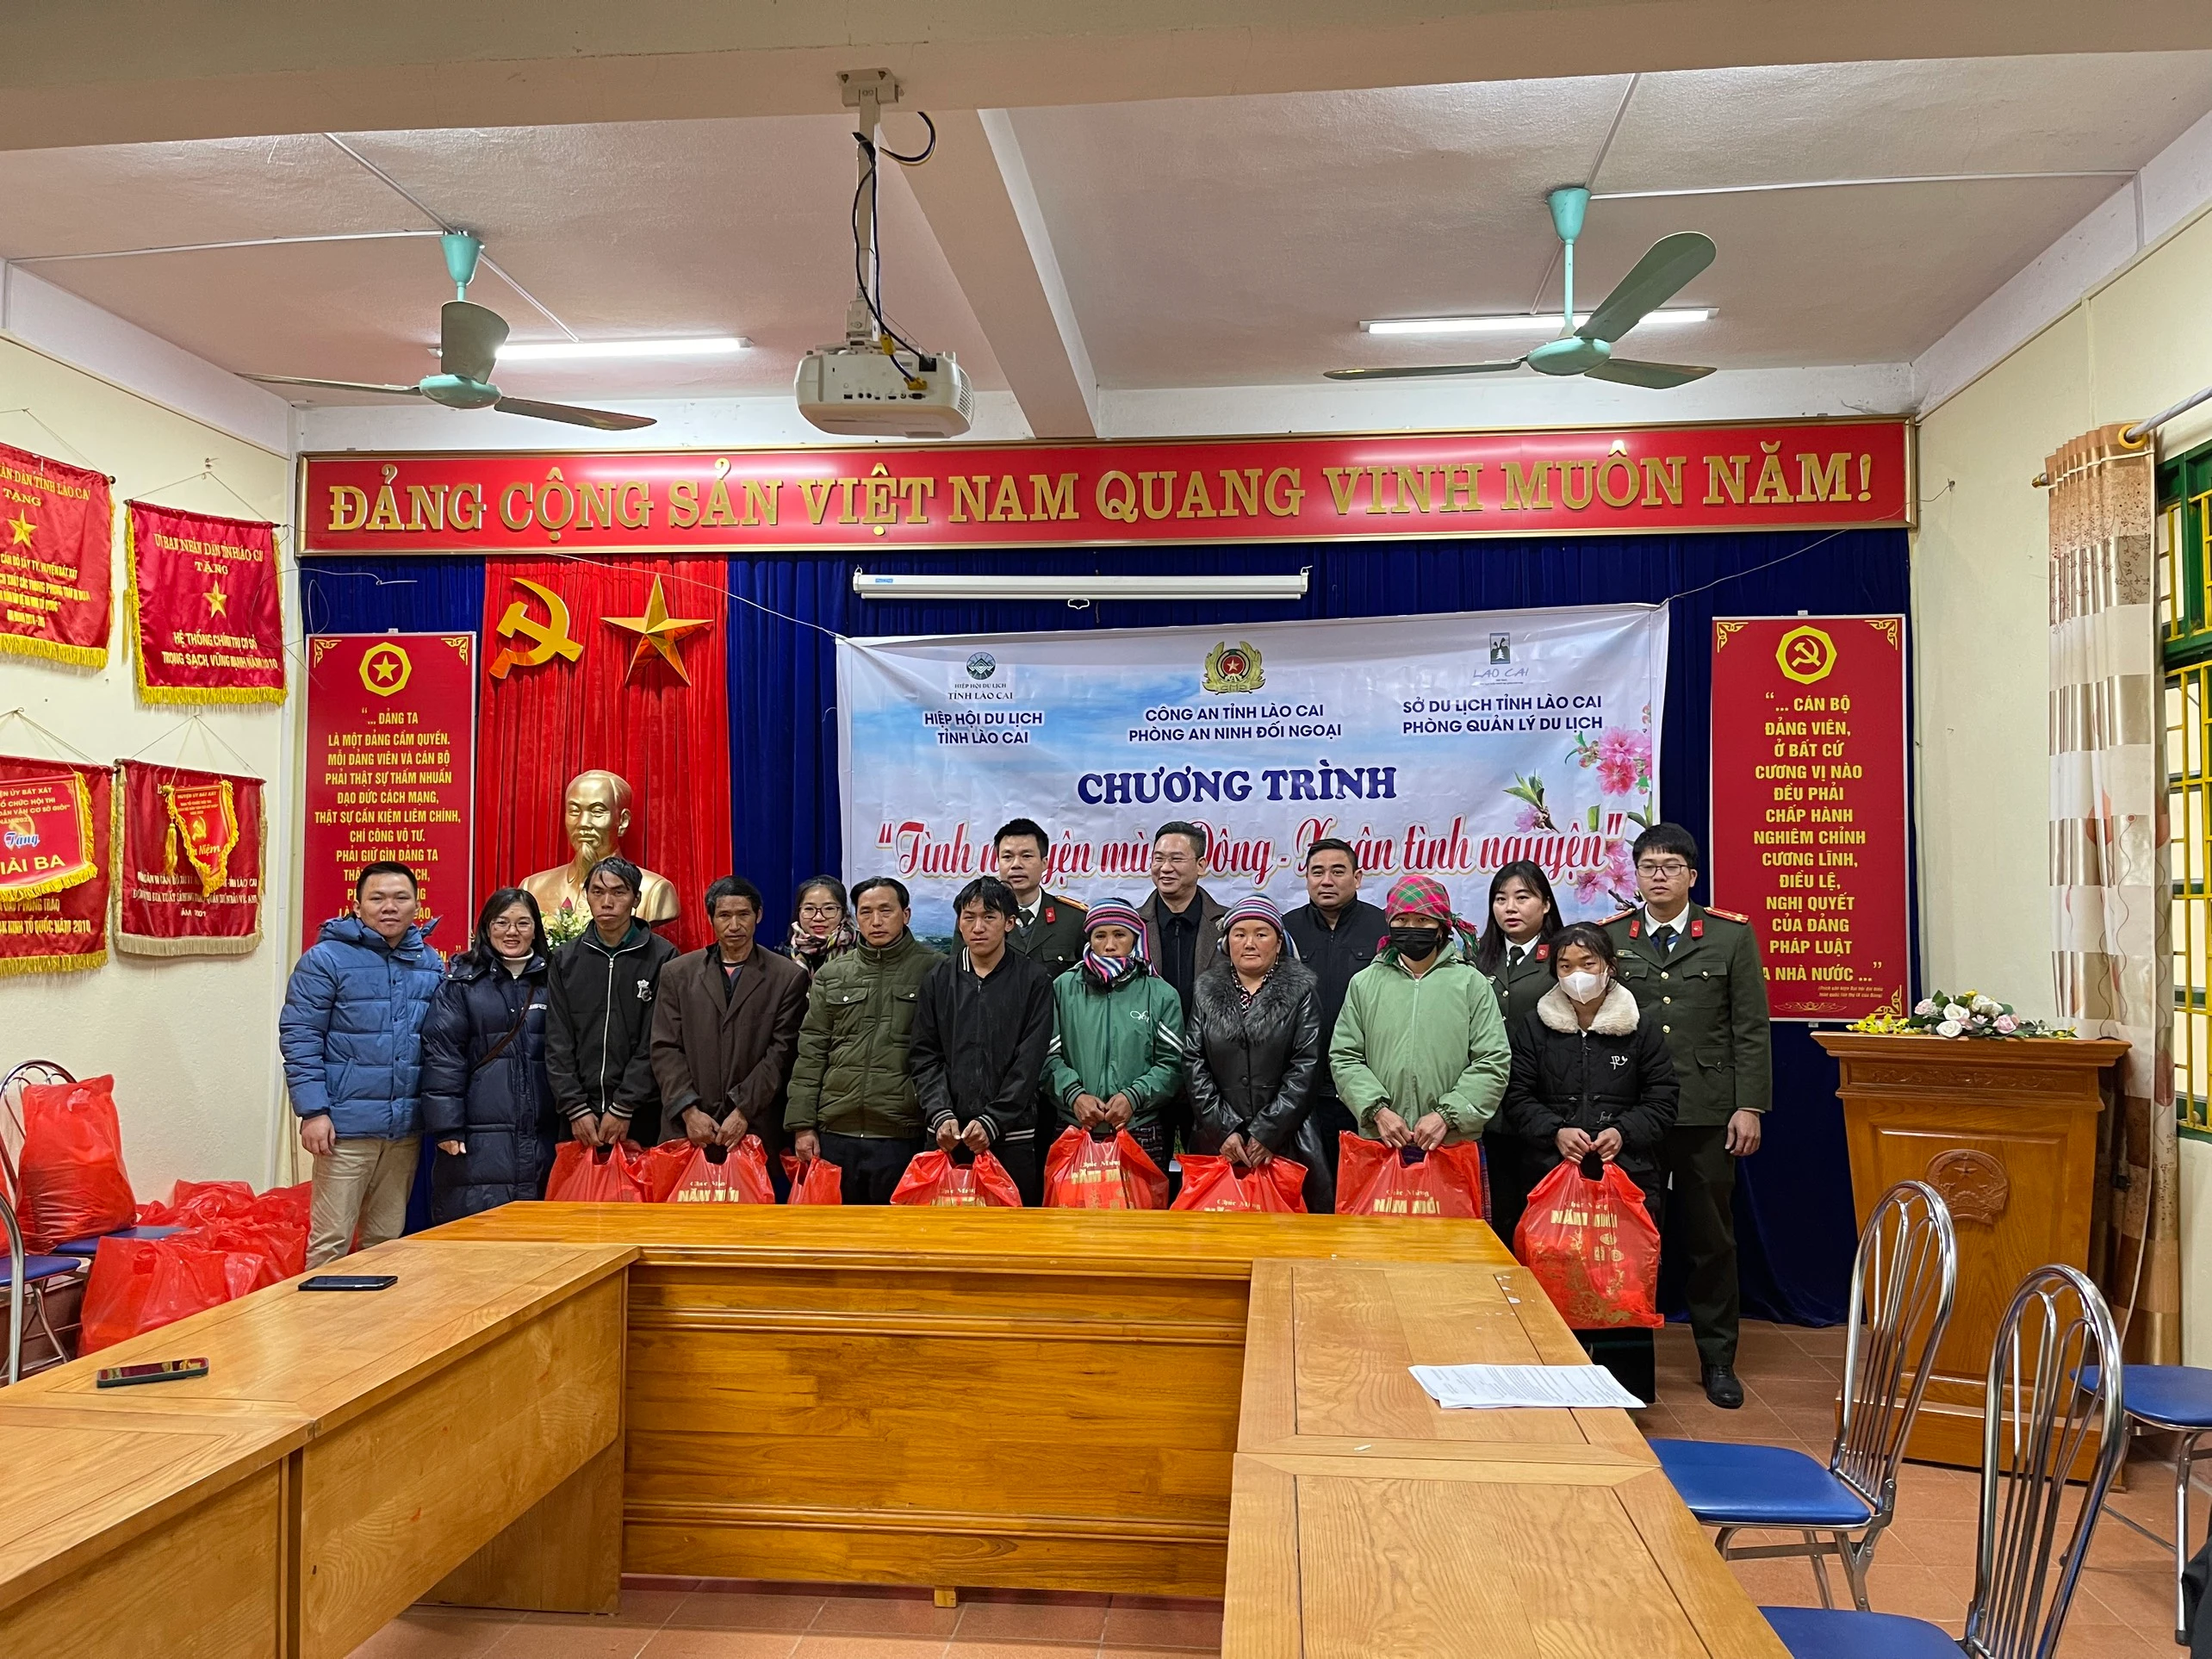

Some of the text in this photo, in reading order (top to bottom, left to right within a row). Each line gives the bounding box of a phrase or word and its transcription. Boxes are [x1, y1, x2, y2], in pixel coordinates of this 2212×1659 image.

[328, 440, 1873, 541] ĐẢNG CỘNG SẢN VIỆT NAM QUANG VINH MUÔN NĂM!
[1145, 703, 1323, 722] CÔNG AN TỈNH LÀO CAI
[1403, 693, 1601, 715] SỞ DU LỊCH TỈNH LÀO CAI
[1793, 695, 1825, 711] CÁN
[1830, 694, 1850, 714] BỘ
[379, 707, 404, 724] ĐẢNG
[407, 712, 419, 724] TA
[925, 710, 1042, 728] HIỆP HỘI DU LỊCH
[1403, 715, 1602, 734] PHÒNG QUẢN LÝ DU LỊCH
[938, 728, 1028, 743] TỈNH LÀO CAI
[1129, 721, 1341, 742] PHÒNG AN NINH ĐỐI NGOẠI
[1765, 717, 1851, 736] ĐẢNG VIÊN,
[328, 732, 339, 747] LÀ
[343, 732, 363, 749] MỘT
[365, 729, 390, 746] ĐẢNG
[1774, 738, 1844, 757] Ở BẤT CỨ
[349, 748, 374, 766] ĐẢNG
[376, 750, 398, 765] VIÊN
[401, 750, 413, 765] VÀ
[415, 749, 435, 765] CÁN
[438, 749, 450, 767] BỘ
[326, 768, 347, 785] PHẢI
[350, 770, 372, 787] THẬT
[376, 771, 389, 787] SỰ
[1755, 762, 1862, 781] CƯƠNG VỊ NÀO
[1078, 759, 1397, 805] CHƯƠNG TRÌNH
[1774, 782, 1844, 801] ĐỀU PHẢI
[337, 789, 439, 806] ĐẠO ĐỨC CÁCH MẠNG,
[314, 809, 338, 826] THẬT
[340, 810, 354, 825] SỰ
[377, 808, 401, 825] KIỆM
[404, 808, 426, 823] LIÊM
[429, 808, 461, 823] CHÍNH,
[1766, 804, 1854, 823] CHẤP HÀNH
[350, 828, 426, 842] CHÍ CÔNG VÔ TƯ.
[1404, 817, 1472, 870] tình
[1754, 826, 1866, 844] NGHIÊM CHỈNH
[336, 844, 438, 861] PHẢI GIỮ GÌN ĐẢNG TA
[1762, 850, 1858, 867] CƯƠNG LĨNH,
[0, 854, 65, 875] IẢI BA
[1780, 870, 1841, 891] ĐIỀU LỆ,
[1767, 892, 1855, 912] NGHỊ QUYẾT
[1772, 913, 1849, 932] CỦA ĐẢNG
[1769, 937, 1852, 957] PHÁP LUẬT
[1775, 965, 1806, 980] NHÀ
[1811, 964, 1854, 981] NƯỚC
